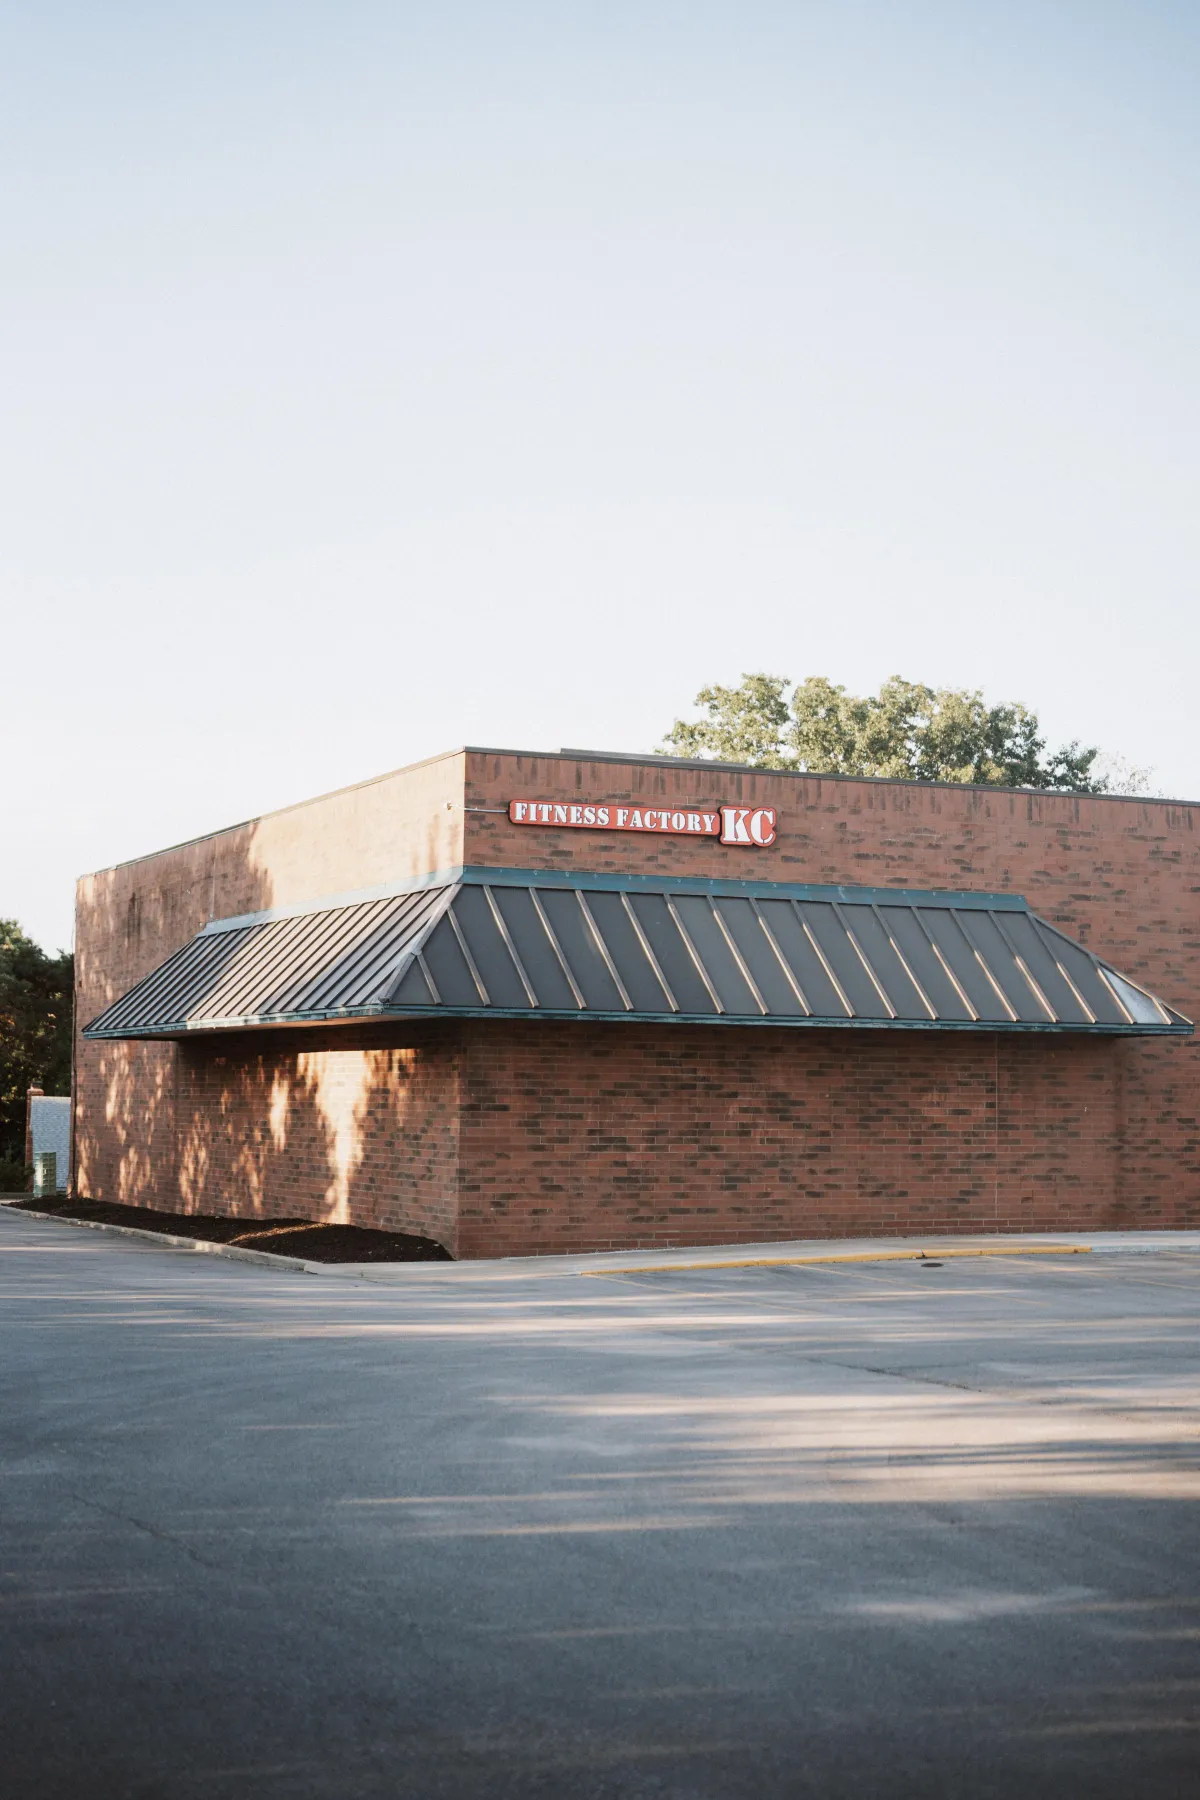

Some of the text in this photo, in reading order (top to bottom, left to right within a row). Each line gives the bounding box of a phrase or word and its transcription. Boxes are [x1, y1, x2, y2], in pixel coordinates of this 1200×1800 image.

[514, 802, 774, 844] FITNESS FACTORY KC
